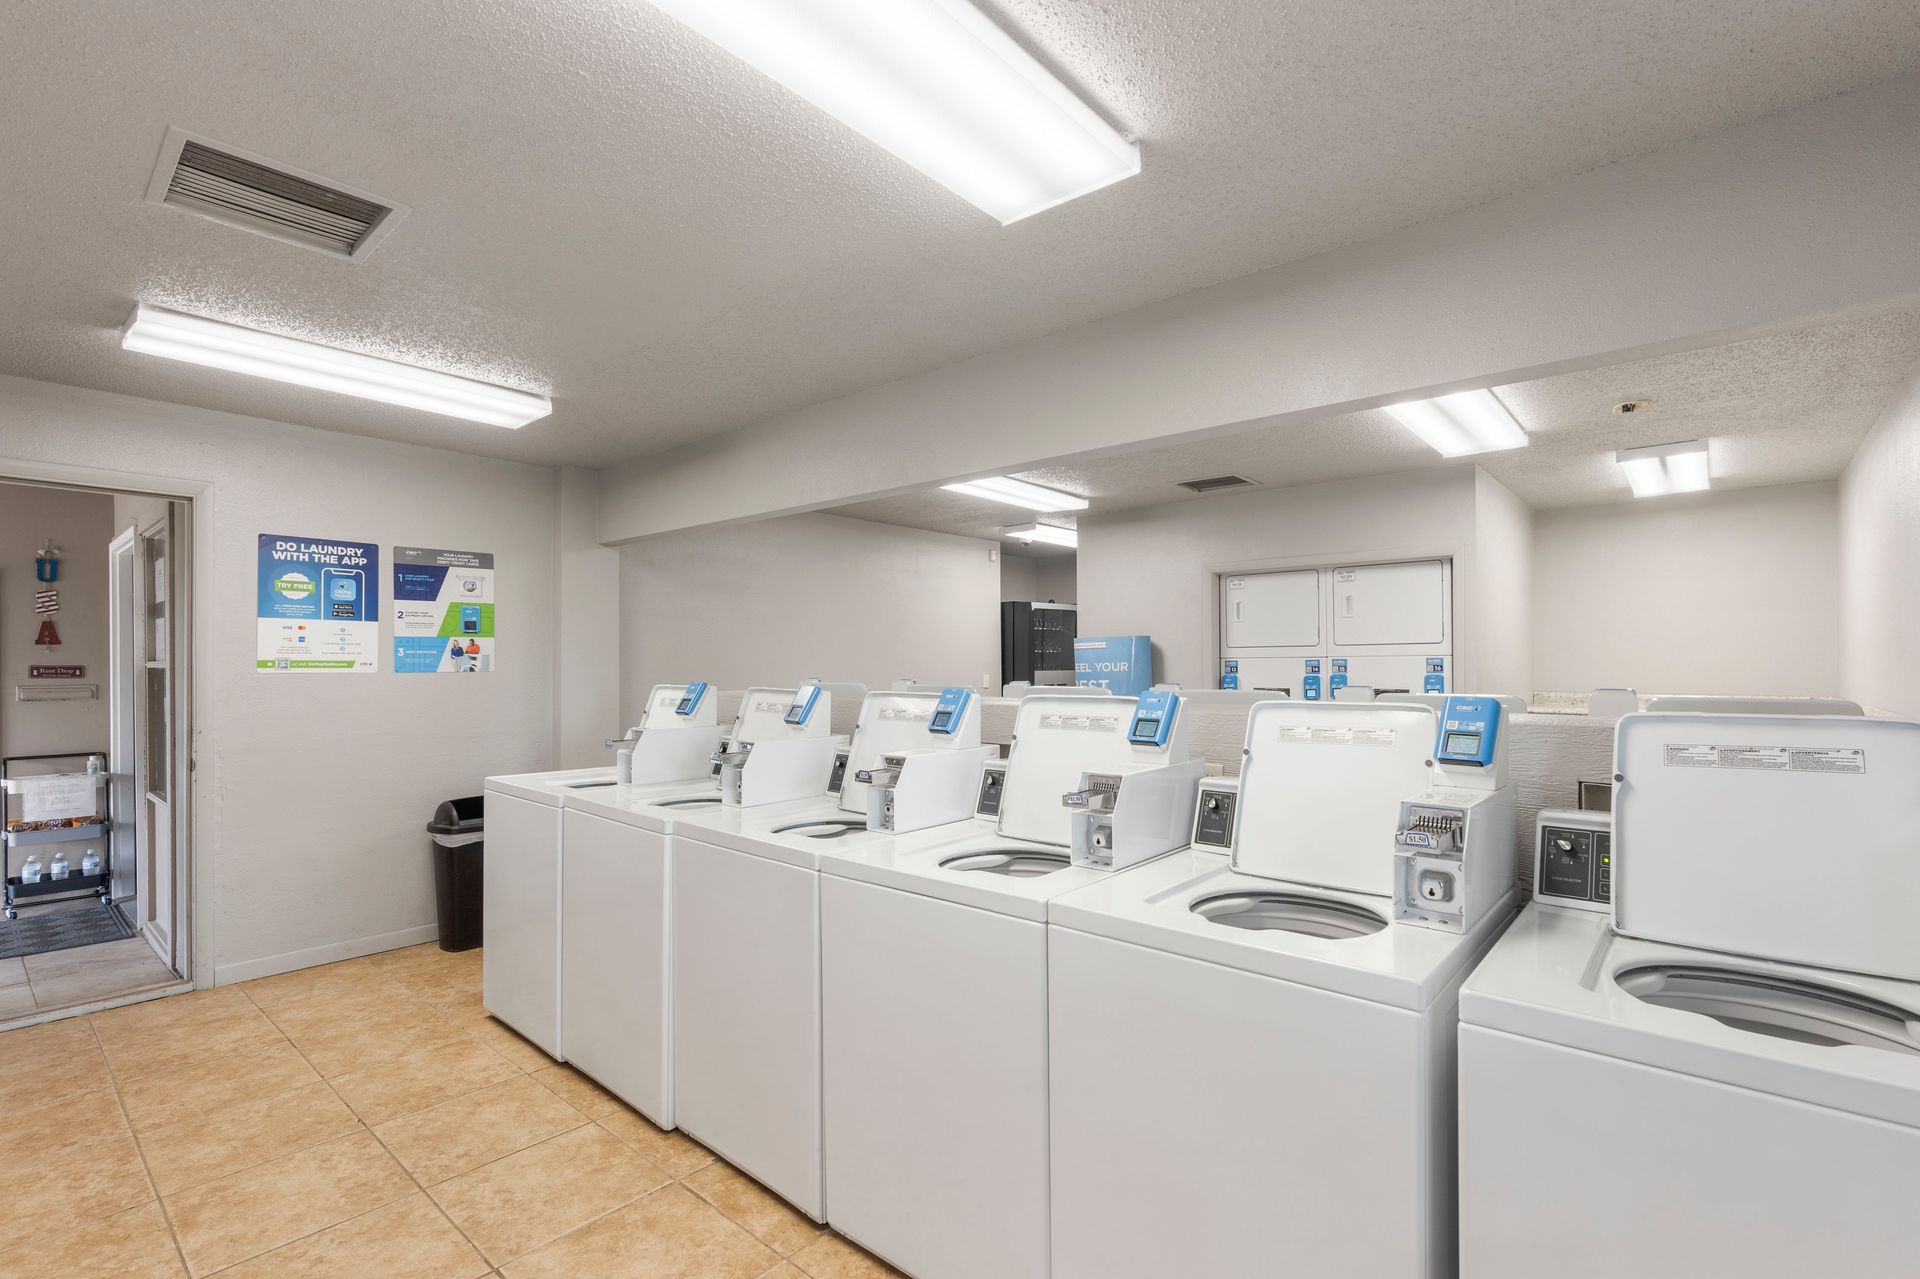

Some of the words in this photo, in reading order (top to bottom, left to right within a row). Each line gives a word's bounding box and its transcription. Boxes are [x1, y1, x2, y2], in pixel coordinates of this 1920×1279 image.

[276, 541, 297, 551] DO
[301, 543, 364, 557] LAUNDRY
[272, 550, 309, 562] WITH
[312, 554, 338, 564] THE
[341, 557, 368, 566] APP
[398, 574, 402, 582] 1
[398, 648, 404, 656] 3
[1075, 663, 1092, 672] EEL
[1094, 662, 1128, 672] YOUR
